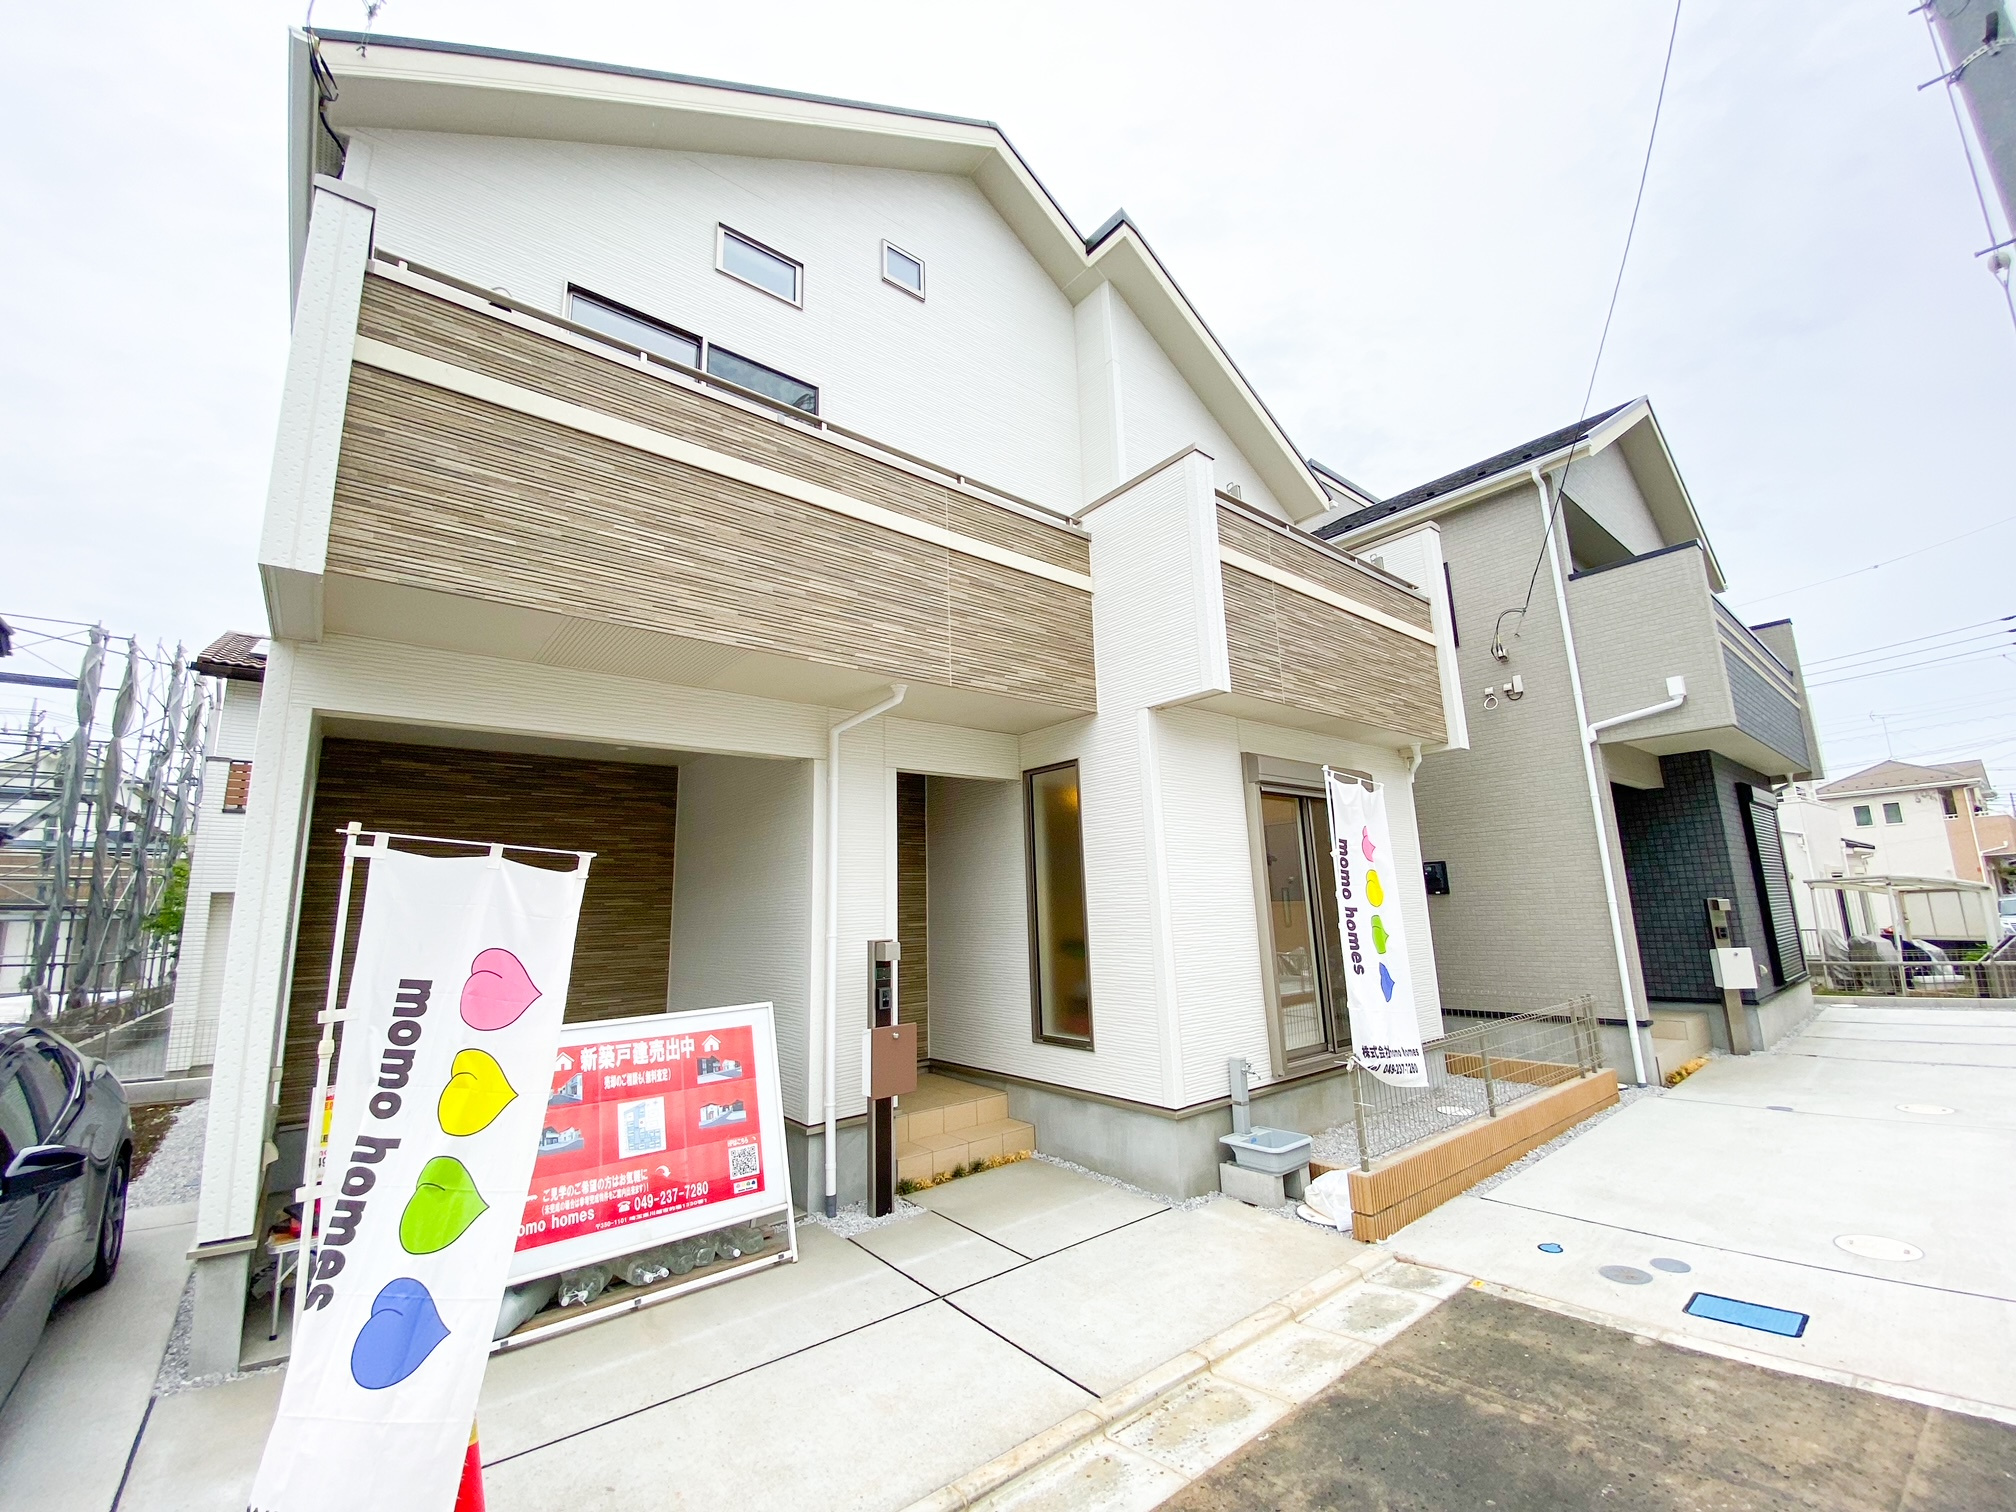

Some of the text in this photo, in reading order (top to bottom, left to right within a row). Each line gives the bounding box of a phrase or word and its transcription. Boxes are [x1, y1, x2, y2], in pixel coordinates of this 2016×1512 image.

[1339, 838, 1365, 975] momo homes
[580, 1035, 695, 1072] 新築戸建売出中
[304, 979, 433, 1311] momo homes
[542, 1169, 648, 1202] ご見学のご希望の方はお気軽に
[634, 1180, 709, 1212] 049-237-7280
[518, 1208, 595, 1237] omo homes
